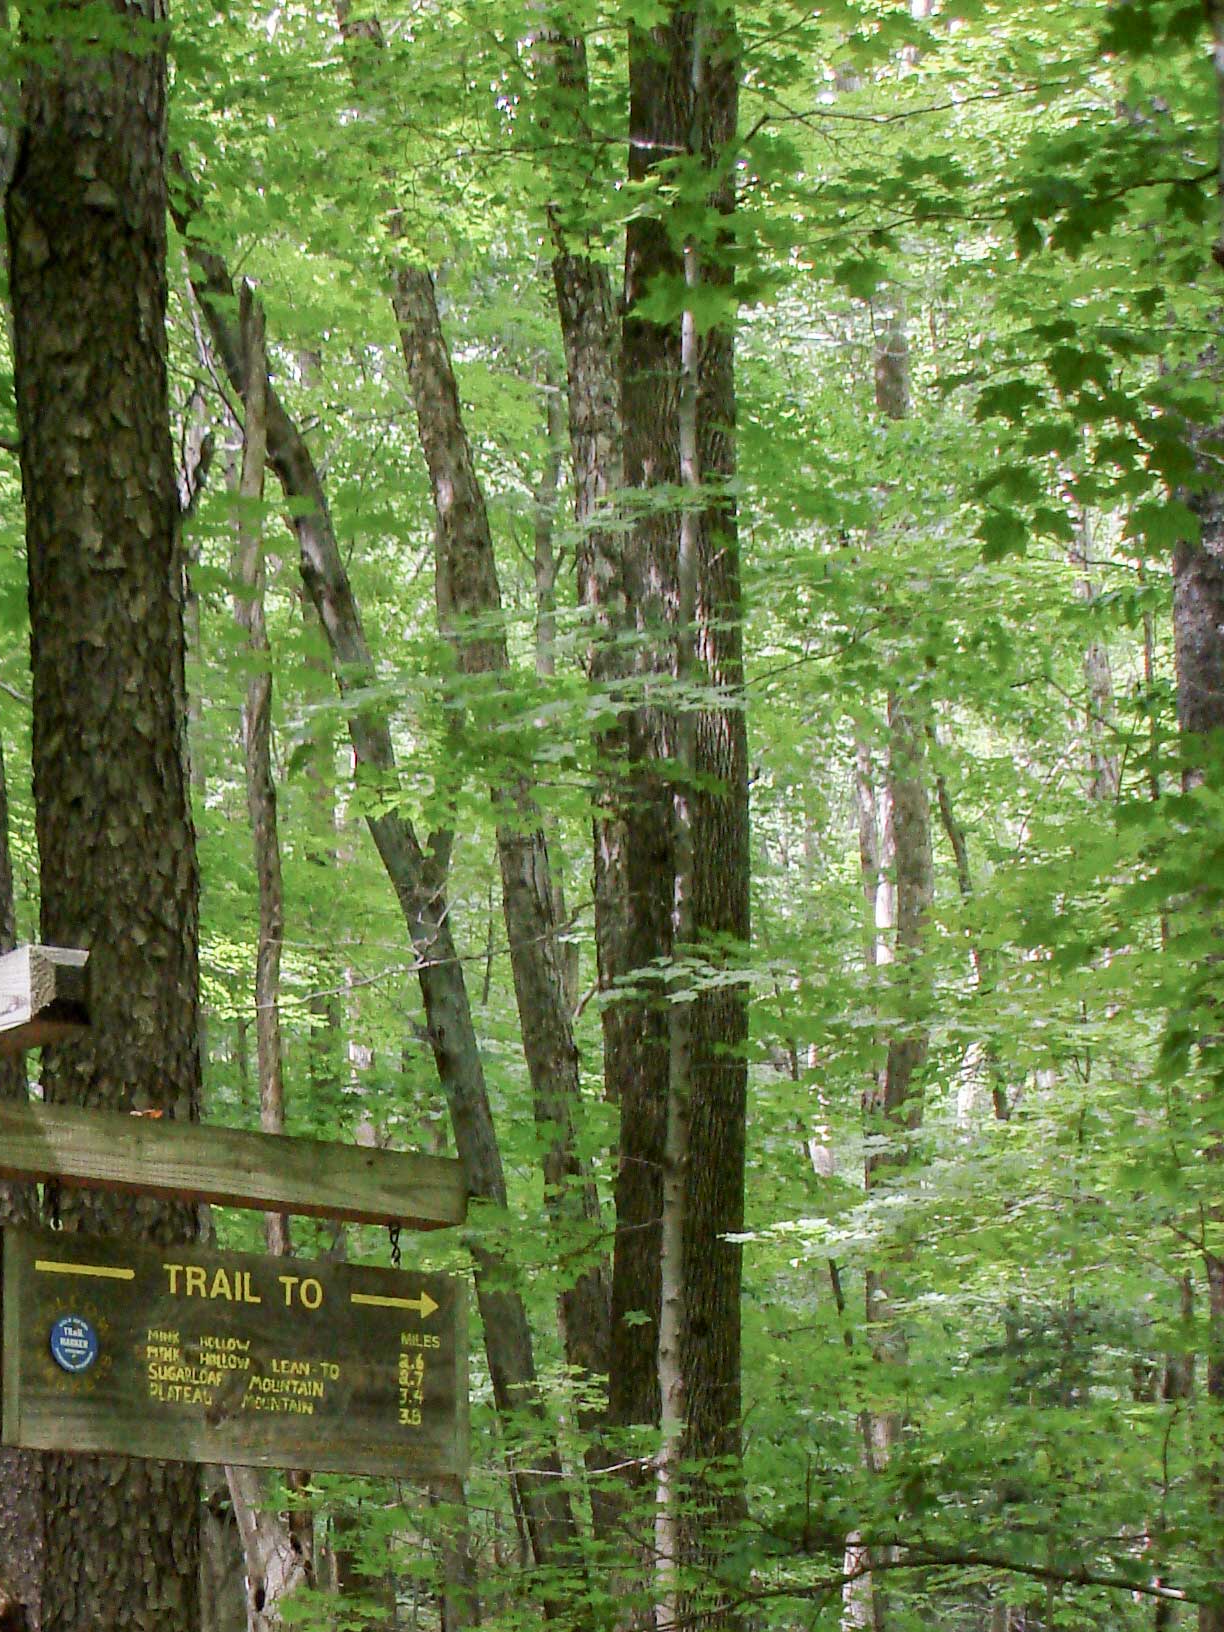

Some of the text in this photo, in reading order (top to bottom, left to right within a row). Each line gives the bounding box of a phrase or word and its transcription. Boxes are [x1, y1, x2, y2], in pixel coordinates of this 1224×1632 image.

[163, 1264, 323, 1309] TRAIL TO
[147, 1329, 180, 1344] MINK
[199, 1336, 251, 1351] HOLLOW
[400, 1331, 441, 1349] MILES
[147, 1346, 180, 1362] MINK
[199, 1353, 250, 1370] HOLLOW
[148, 1363, 224, 1386] SUGARLOAF
[249, 1376, 324, 1398] MOUNTAIN
[149, 1382, 212, 1406] PLATEAU
[241, 1395, 314, 1415] MOUNTAIN
